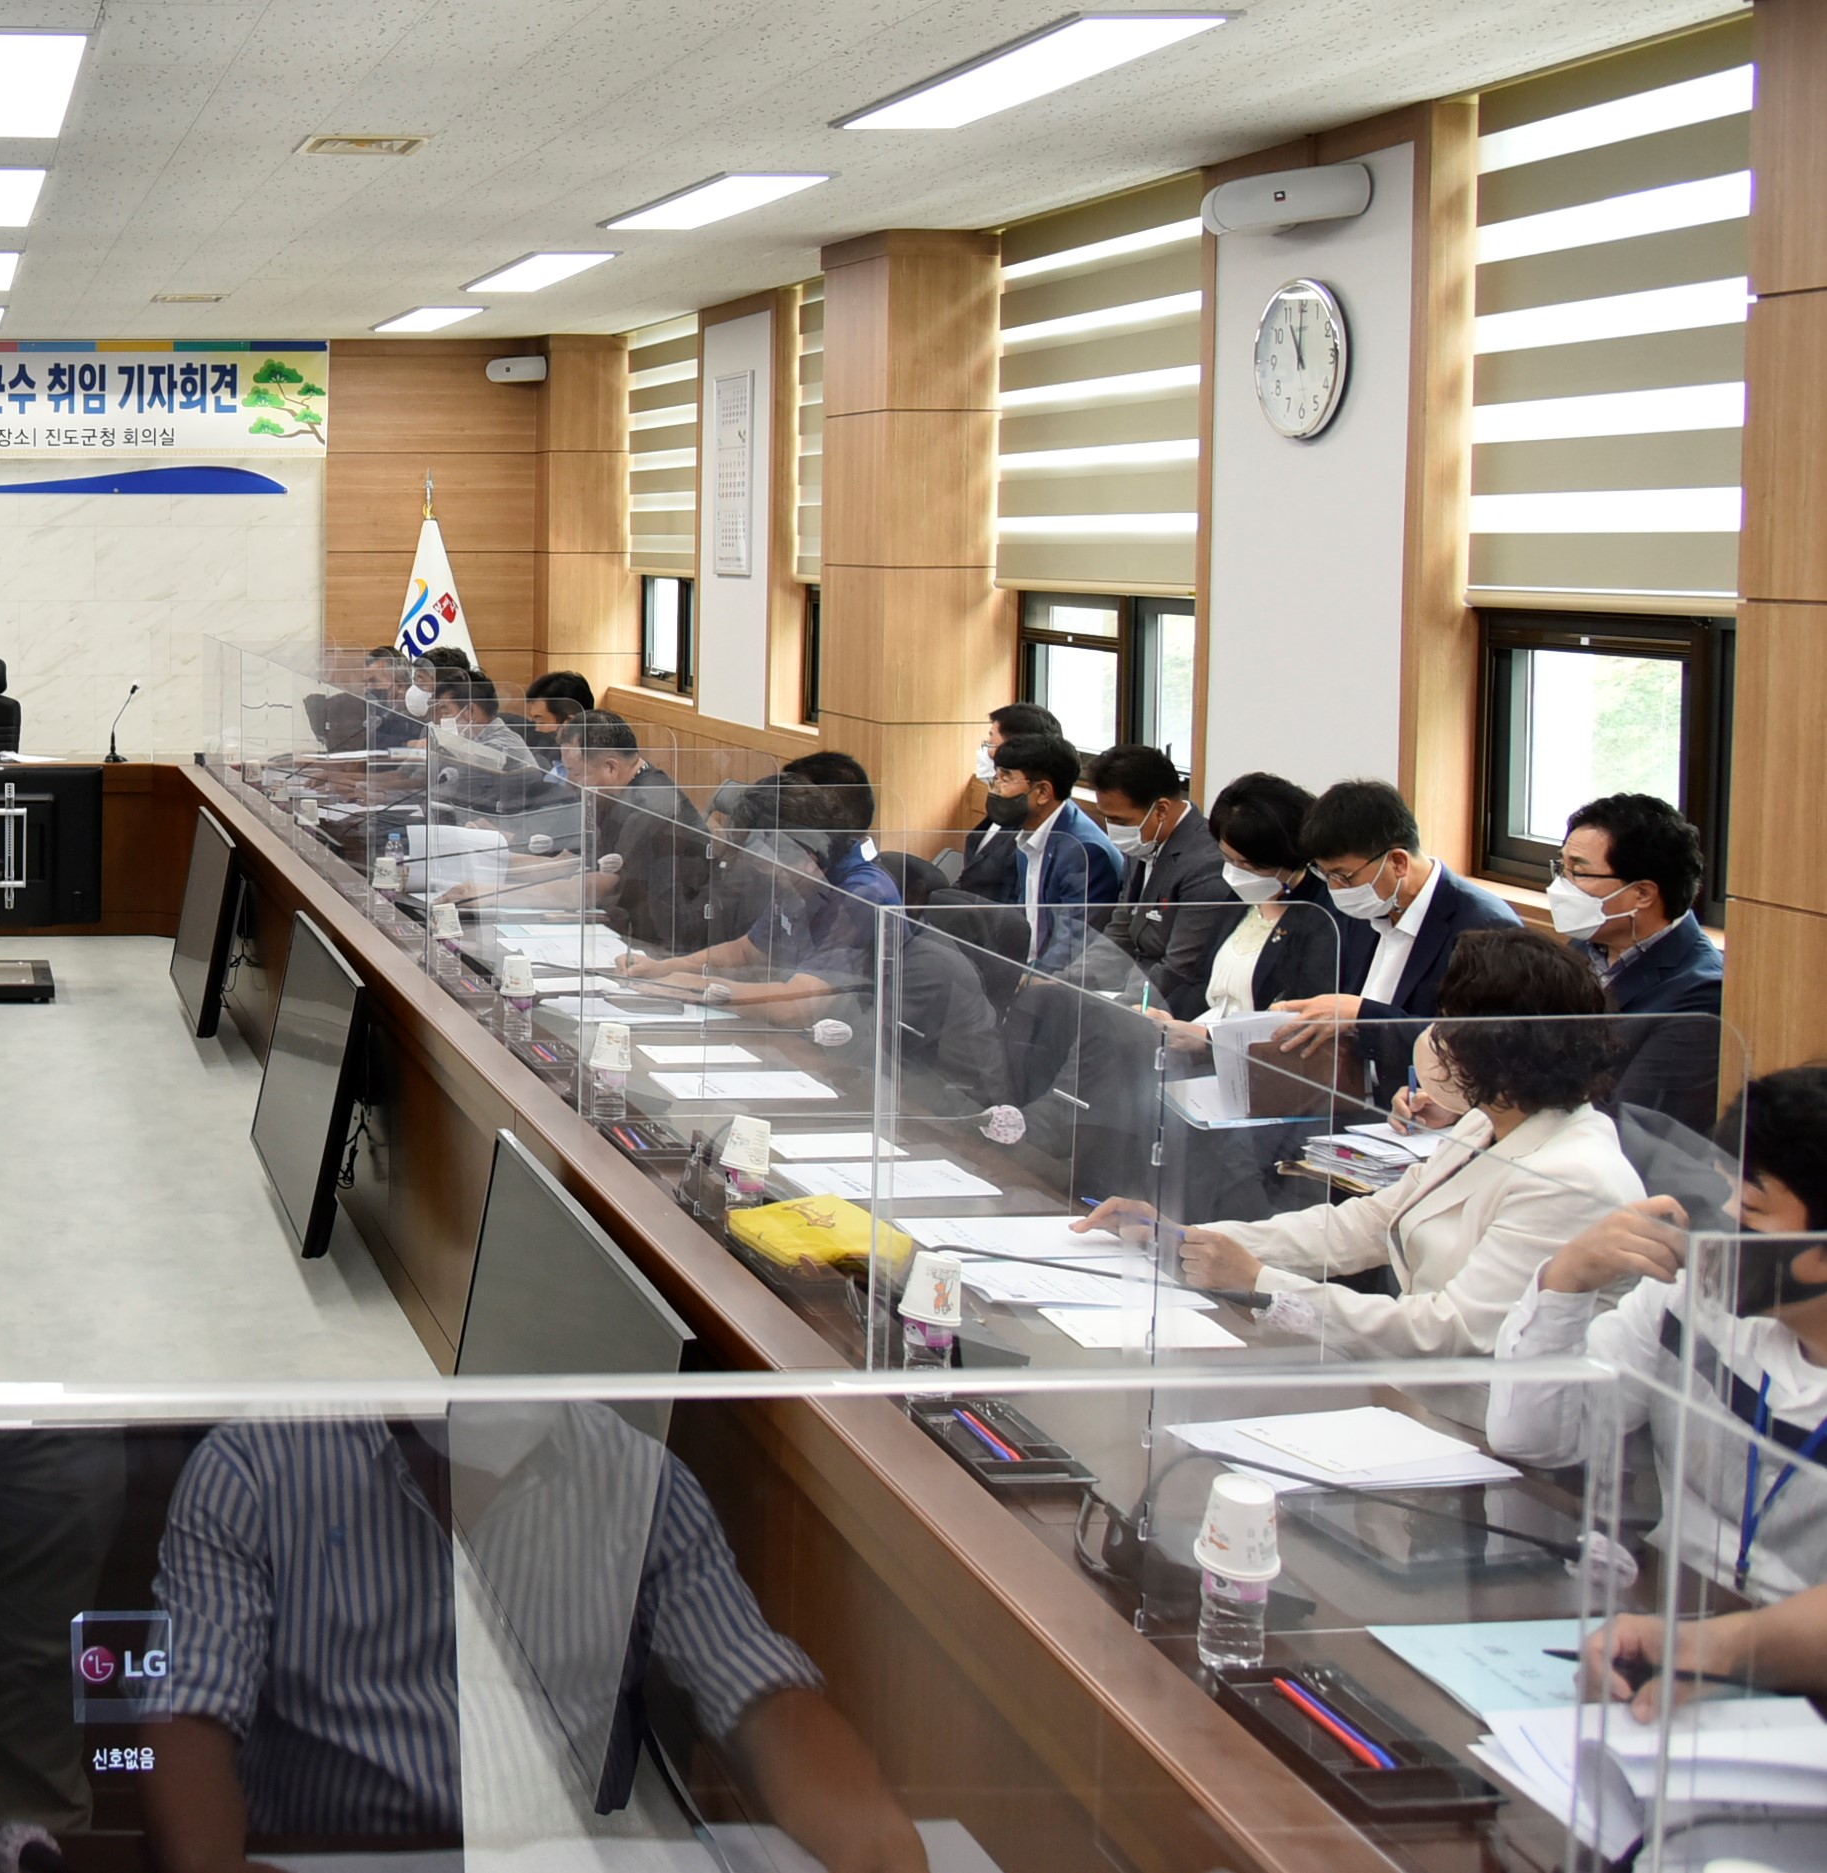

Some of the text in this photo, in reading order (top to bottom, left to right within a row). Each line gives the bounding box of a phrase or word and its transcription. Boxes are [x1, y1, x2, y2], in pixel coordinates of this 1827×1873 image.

[1274, 328, 1284, 345] 10
[1270, 354, 1278, 371] 9
[47, 363, 106, 414] 취임
[117, 363, 238, 414] 기자회견
[1275, 380, 1282, 397] 8
[1322, 376, 1330, 391] 4
[1285, 397, 1292, 413] 7
[1298, 402, 1306, 419] 6
[1312, 395, 1320, 412] 5
[45, 427, 116, 447] 진도군청
[123, 427, 175, 447] 회의실
[124, 1650, 167, 1678] LG
[92, 1746, 156, 1771] 신호없음
